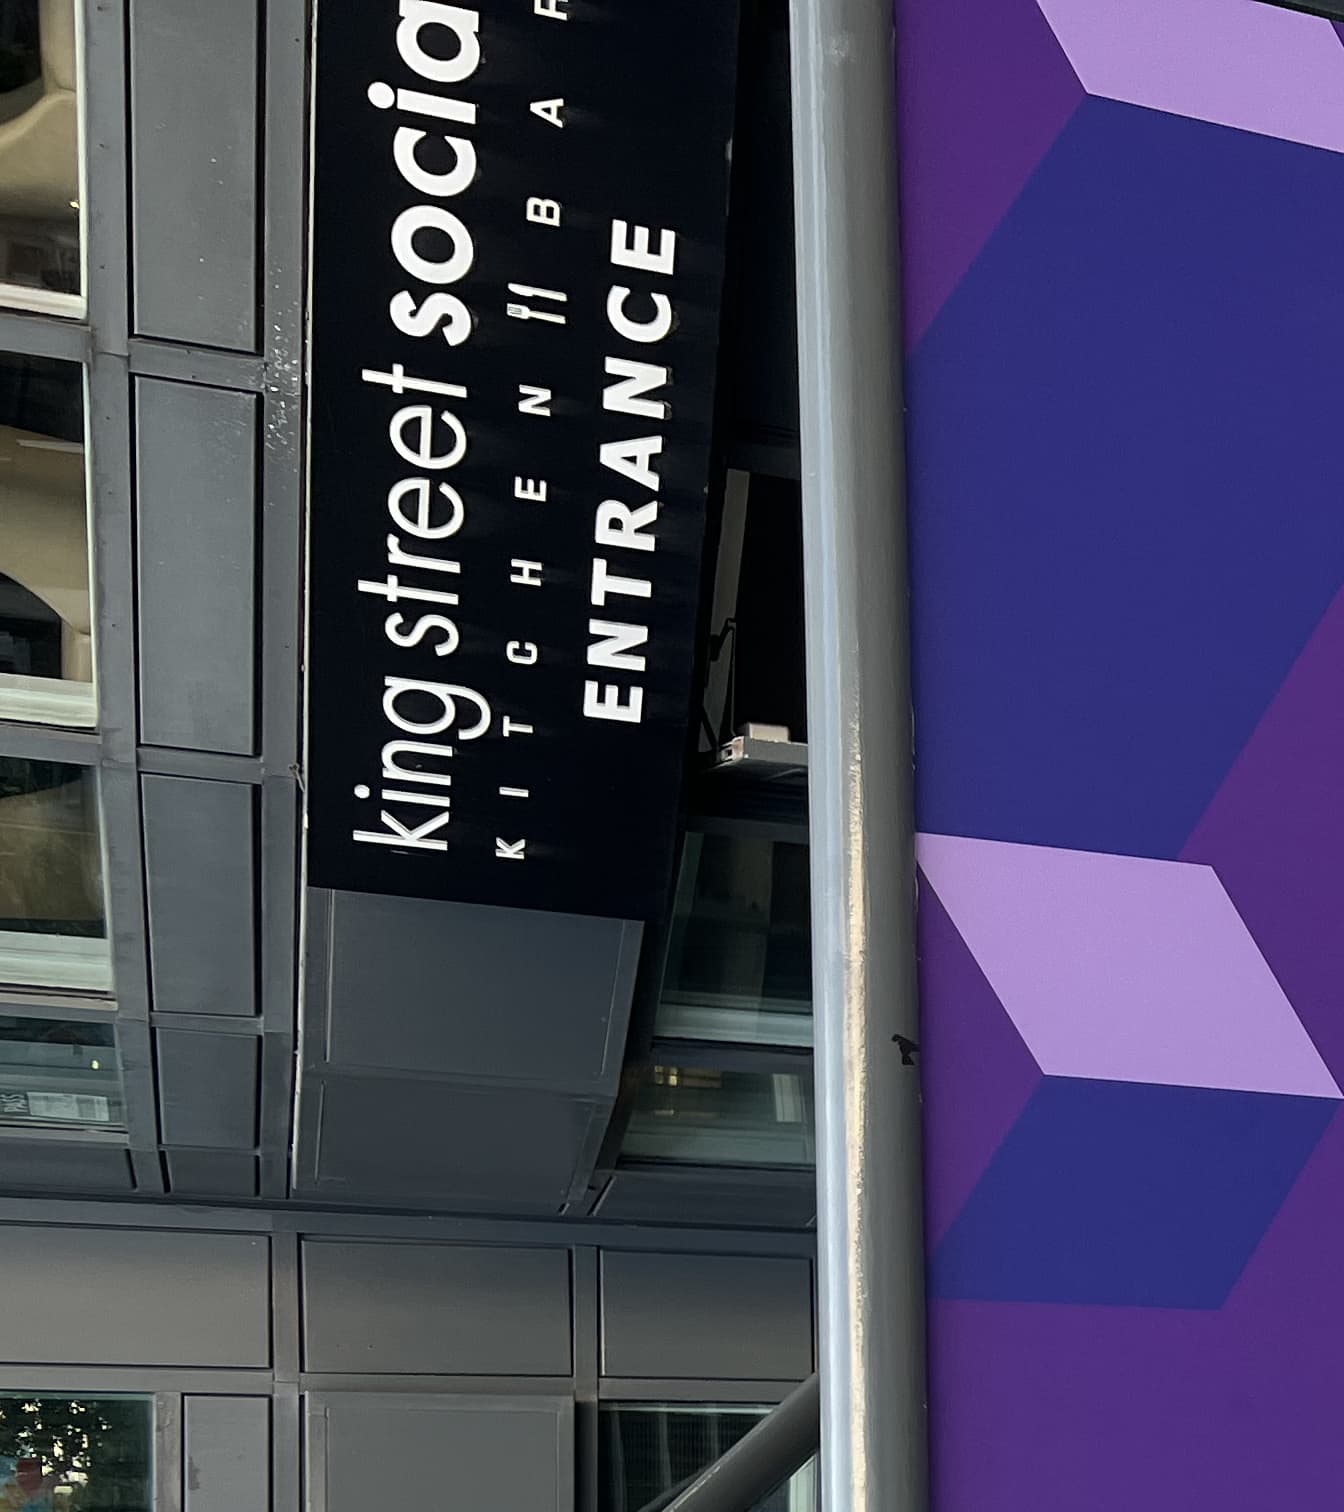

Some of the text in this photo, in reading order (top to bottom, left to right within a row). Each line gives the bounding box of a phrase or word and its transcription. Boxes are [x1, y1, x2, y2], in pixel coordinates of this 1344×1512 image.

[357, 363, 468, 657] street
[495, 384, 552, 860] KITCHEN
[582, 219, 676, 724] ENTRANCE
[352, 675, 491, 851] king
